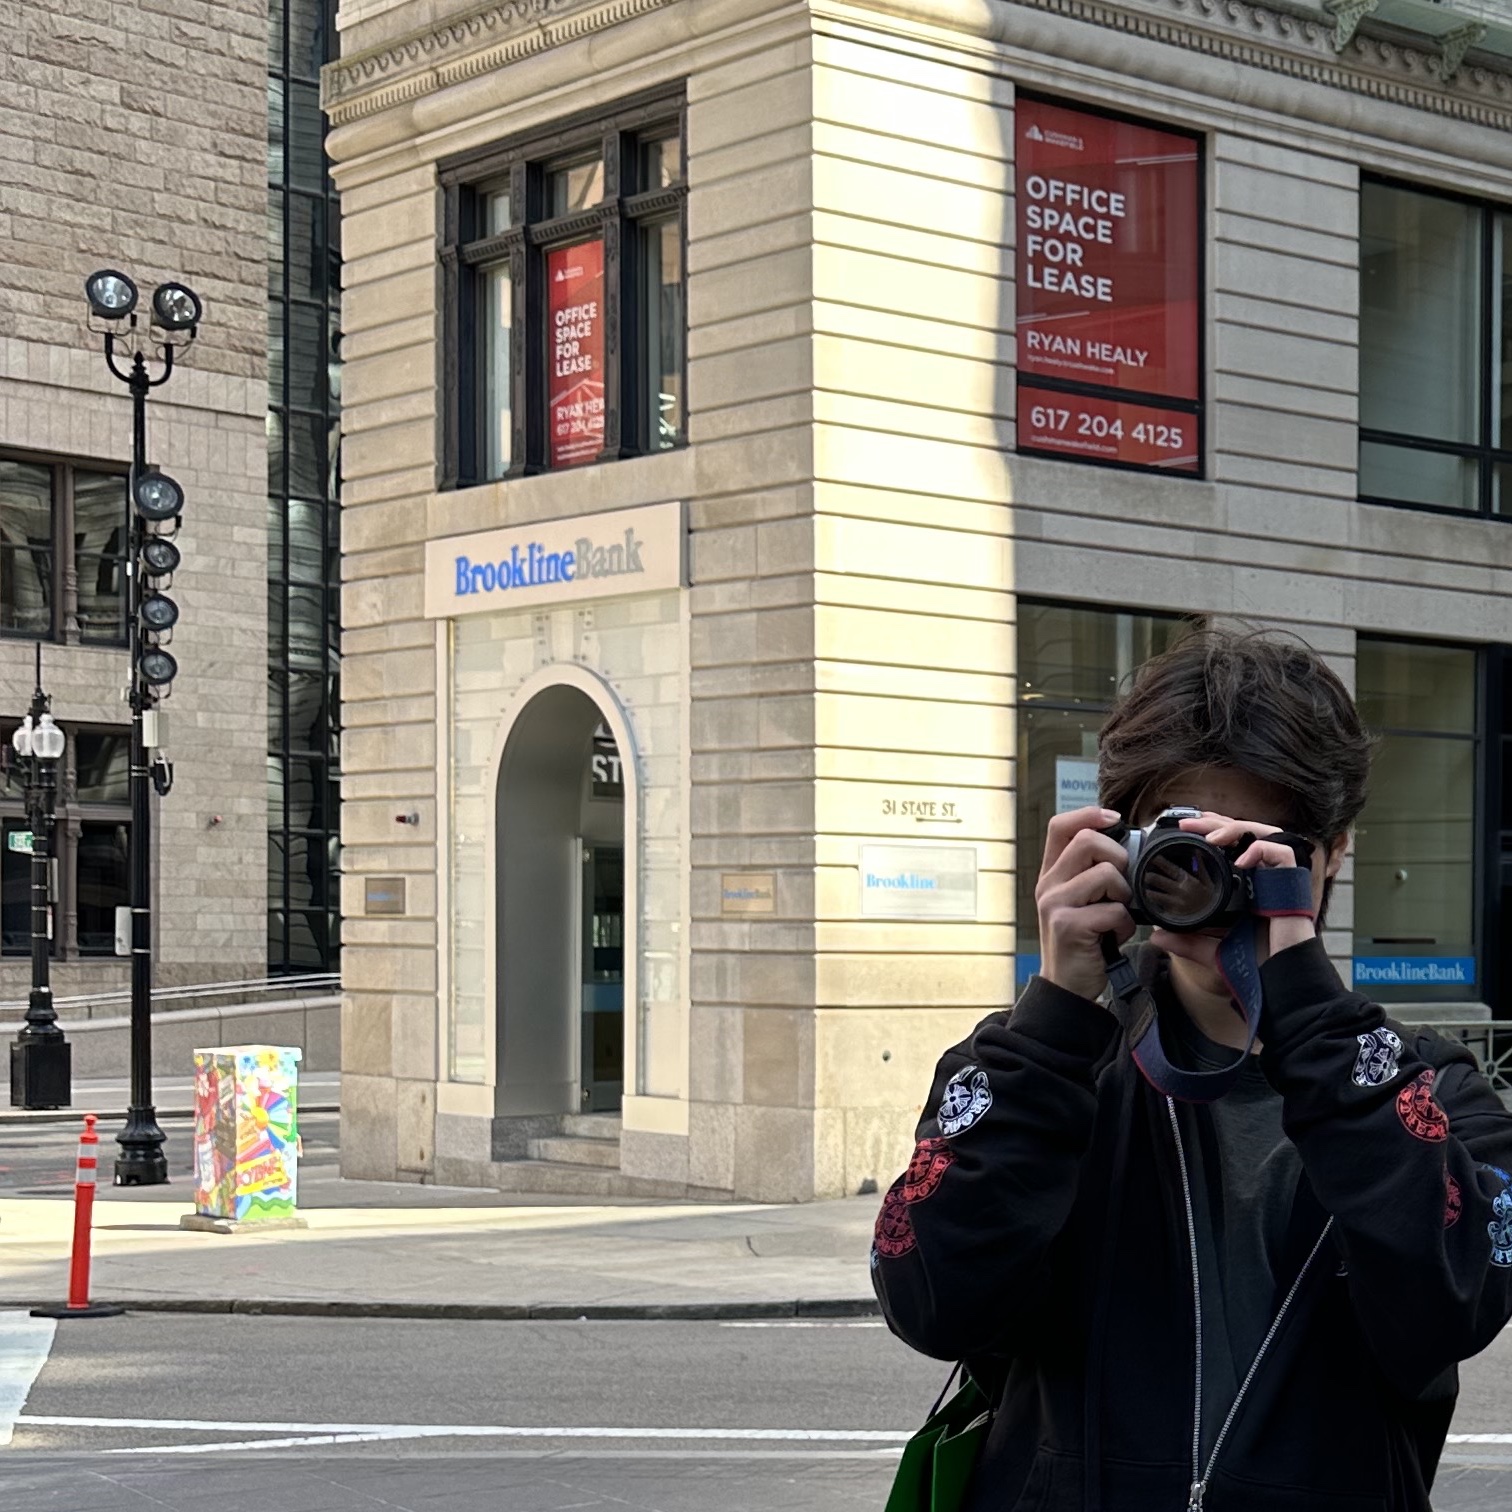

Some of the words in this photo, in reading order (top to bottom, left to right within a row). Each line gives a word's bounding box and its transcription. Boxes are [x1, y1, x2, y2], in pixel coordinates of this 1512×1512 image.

[1026, 175, 1126, 218] OFFICE
[1026, 205, 1113, 244] SPACE
[1027, 234, 1083, 267] FOR
[1027, 264, 1113, 302] LEASE
[555, 301, 597, 326] OFFICE
[555, 320, 592, 343] SPACE
[556, 341, 580, 360] FOR
[1027, 330, 1081, 357] RYAN
[1086, 340, 1149, 367] HEALY
[556, 354, 592, 377] LEASE
[1031, 406, 1070, 431] 617
[1077, 413, 1124, 440] 204
[1131, 422, 1183, 449] 4125
[882, 799, 896, 815] 31
[900, 800, 937, 816] STATE
[1356, 961, 1466, 981] BrooklineBank
